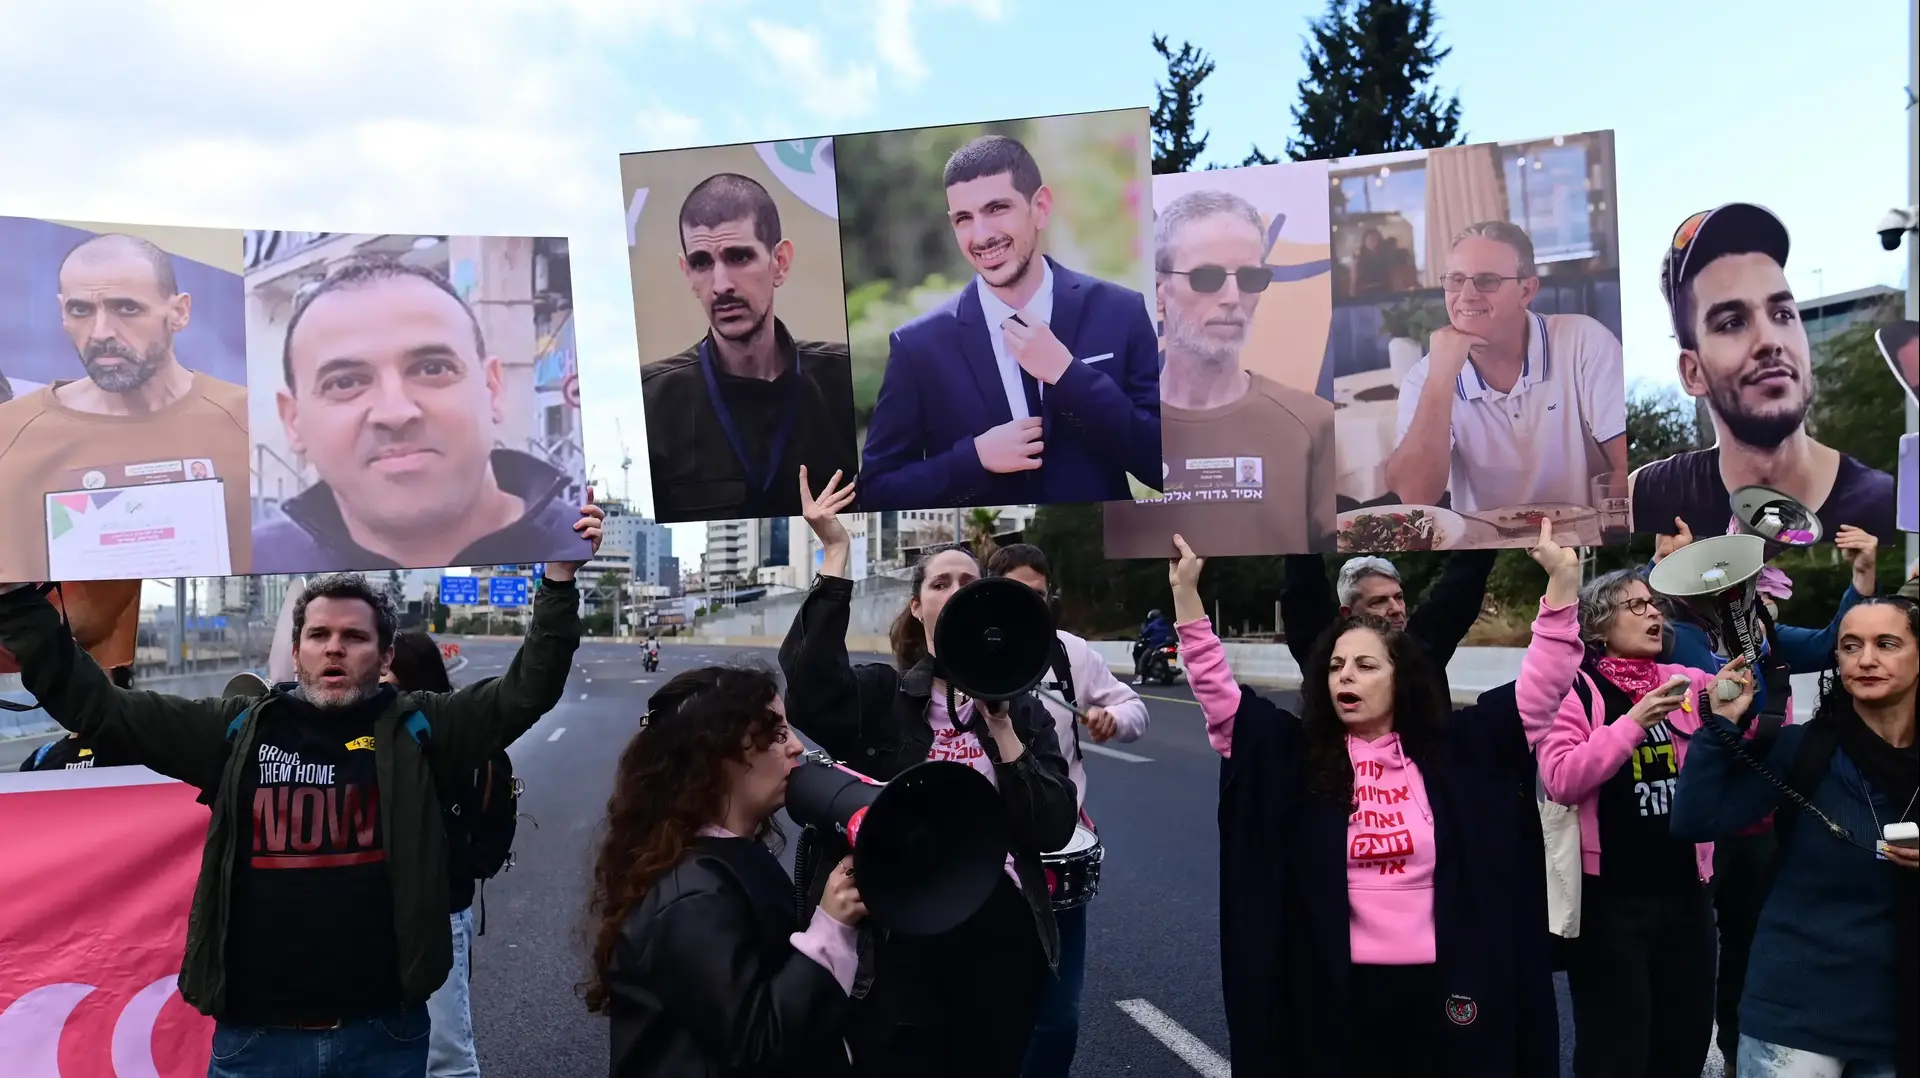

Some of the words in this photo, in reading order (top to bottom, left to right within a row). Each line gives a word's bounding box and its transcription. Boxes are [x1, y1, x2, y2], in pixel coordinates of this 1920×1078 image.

[1195, 490, 1228, 500] גדודי
[1231, 489, 1263, 499] אסיר
[258, 743, 301, 766] BRING
[259, 762, 292, 784] THEM
[295, 763, 335, 785] HOME
[252, 783, 379, 852] NOW
[1354, 834, 1409, 857] זועק
